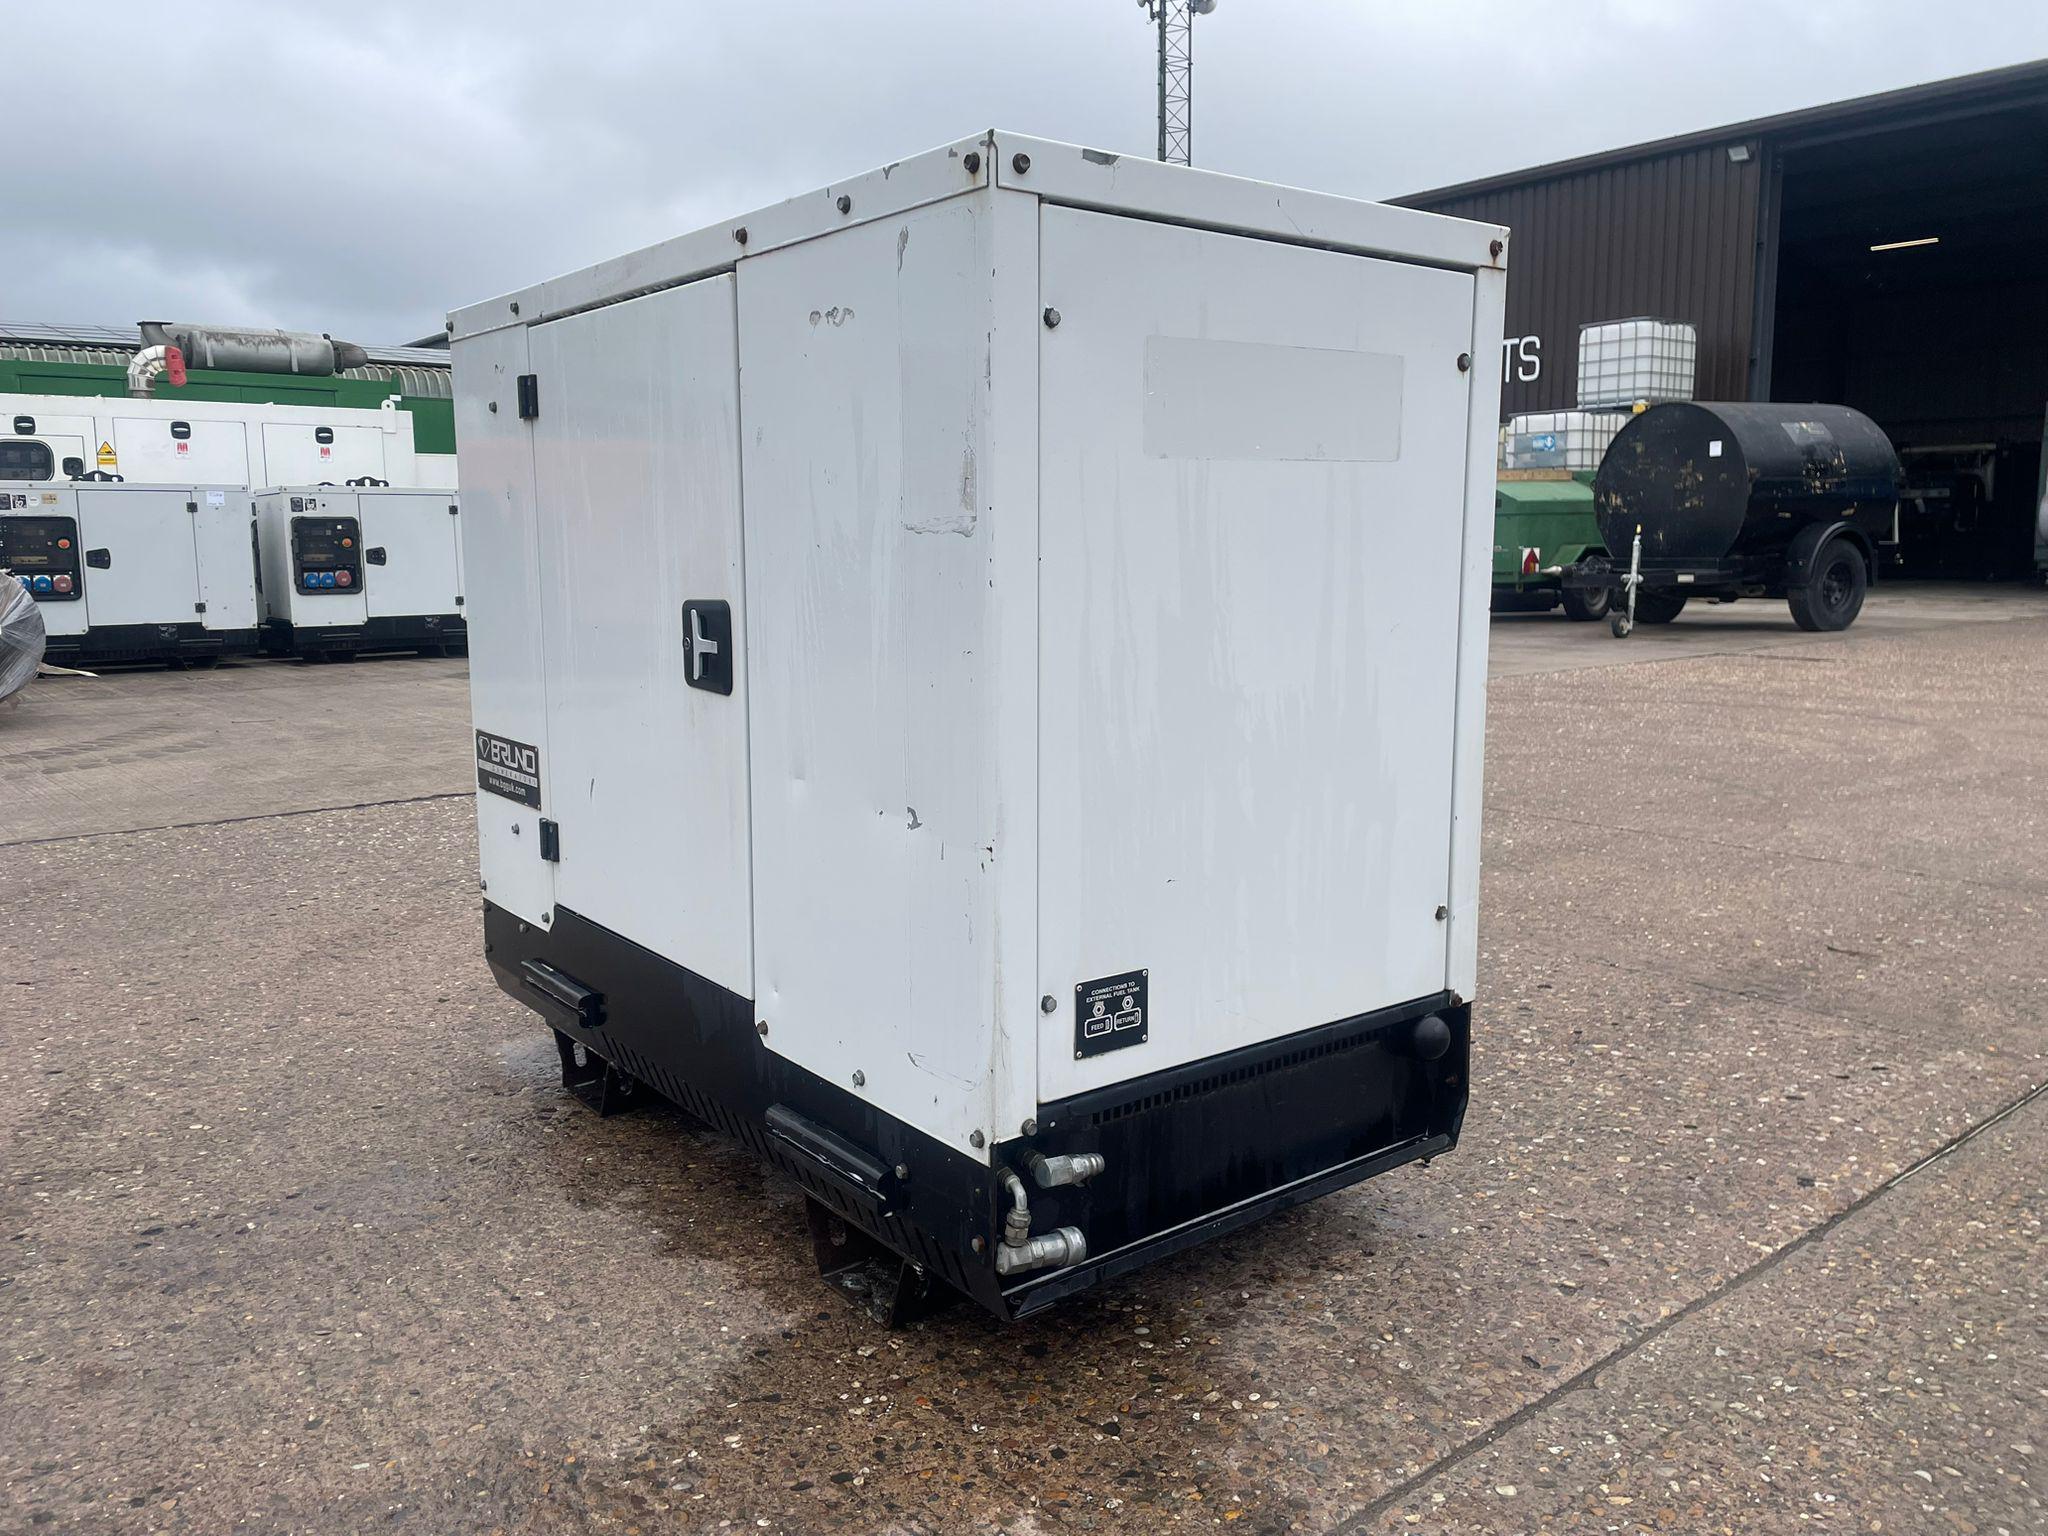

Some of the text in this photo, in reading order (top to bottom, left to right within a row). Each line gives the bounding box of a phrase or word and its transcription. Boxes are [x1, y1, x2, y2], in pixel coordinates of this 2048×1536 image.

[1503, 335, 1541, 383] TS
[490, 739, 536, 774] BRUNO
[1086, 986, 1140, 1003] EXTERNAL FUEL TANK
[1091, 983, 1128, 996] CONNECTIONS
[1091, 1022, 1105, 1031] FEED
[1116, 1015, 1135, 1025] RETURN
